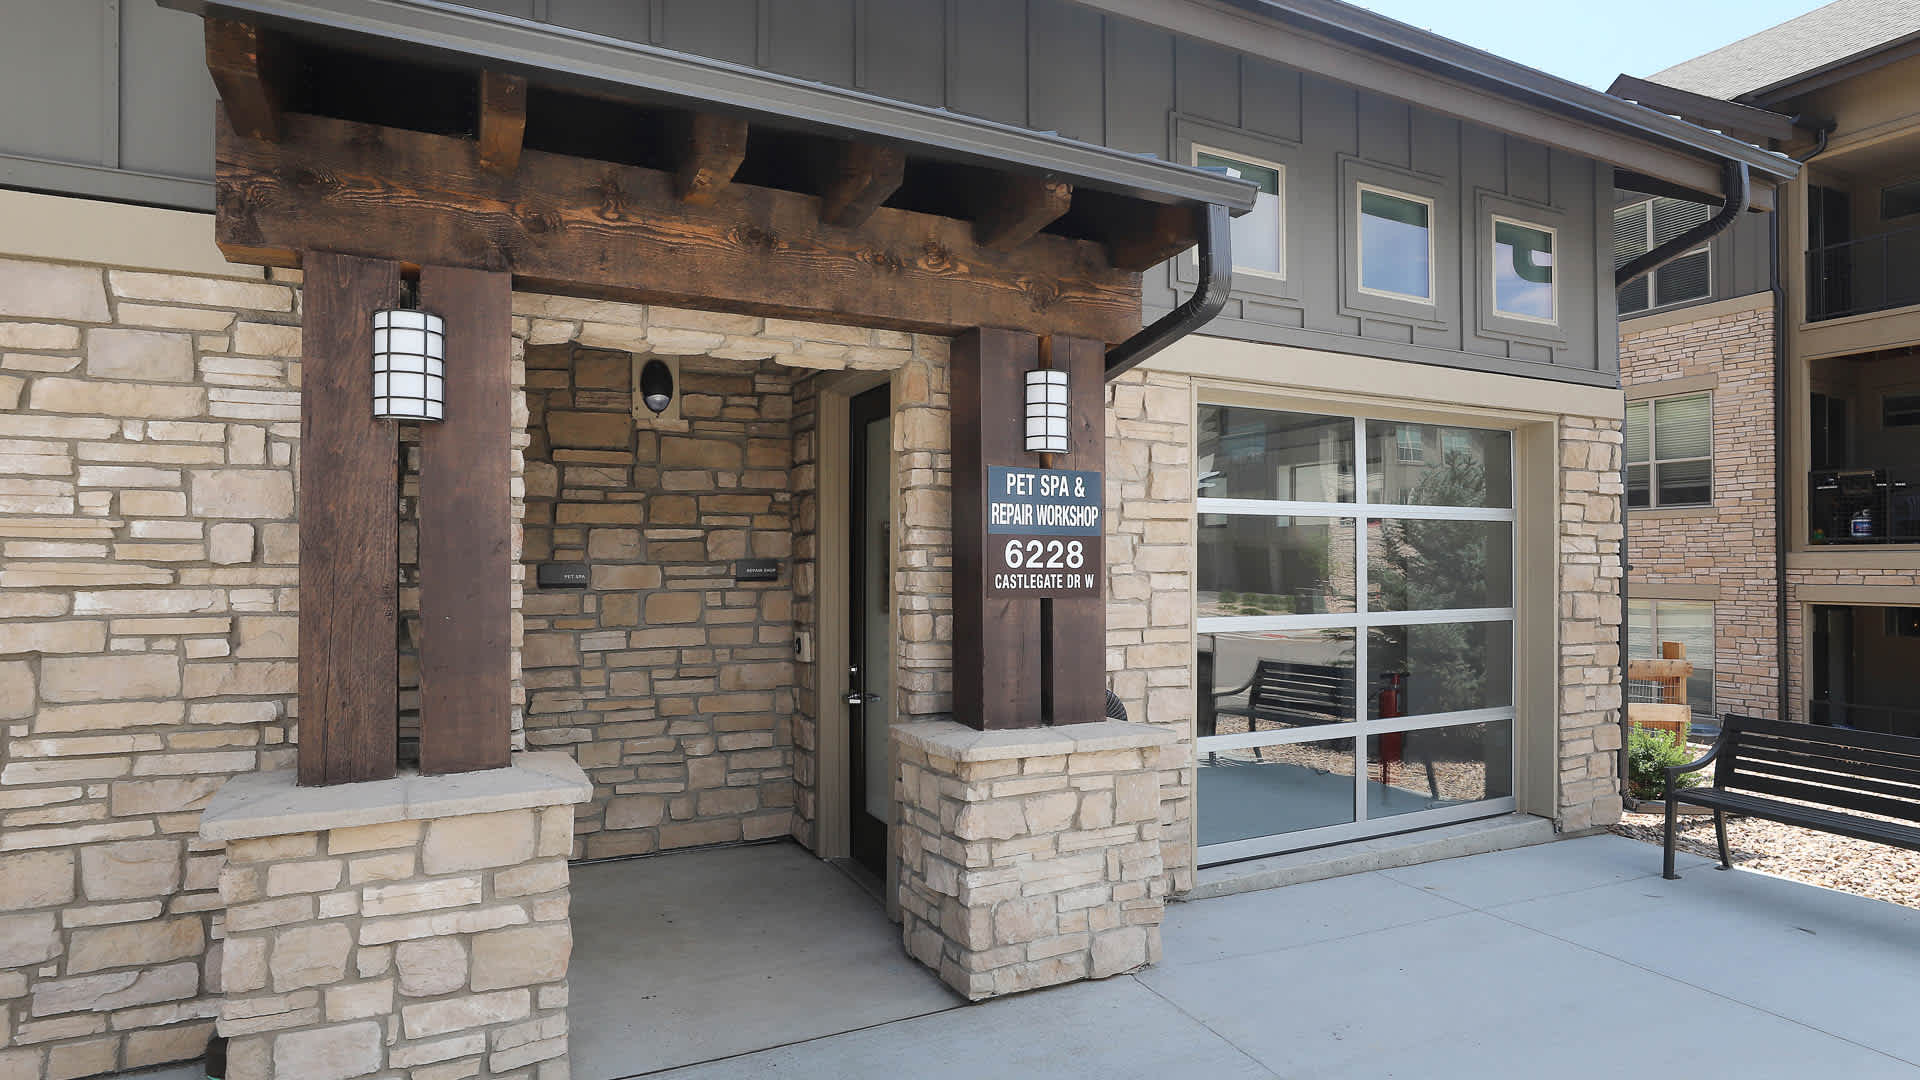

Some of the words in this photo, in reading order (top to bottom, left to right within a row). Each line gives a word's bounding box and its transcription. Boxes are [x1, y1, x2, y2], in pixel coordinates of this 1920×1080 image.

[1006, 472, 1035, 496] PET
[1040, 474, 1069, 497] SPA
[1074, 476, 1086, 498] &
[991, 502, 1033, 525] REPAIR
[1036, 504, 1099, 527] WORKSHOP
[1004, 539, 1084, 569] 6228
[994, 573, 1063, 589] CASTLEGATE
[1067, 573, 1081, 589] DR
[1084, 573, 1095, 588] W
